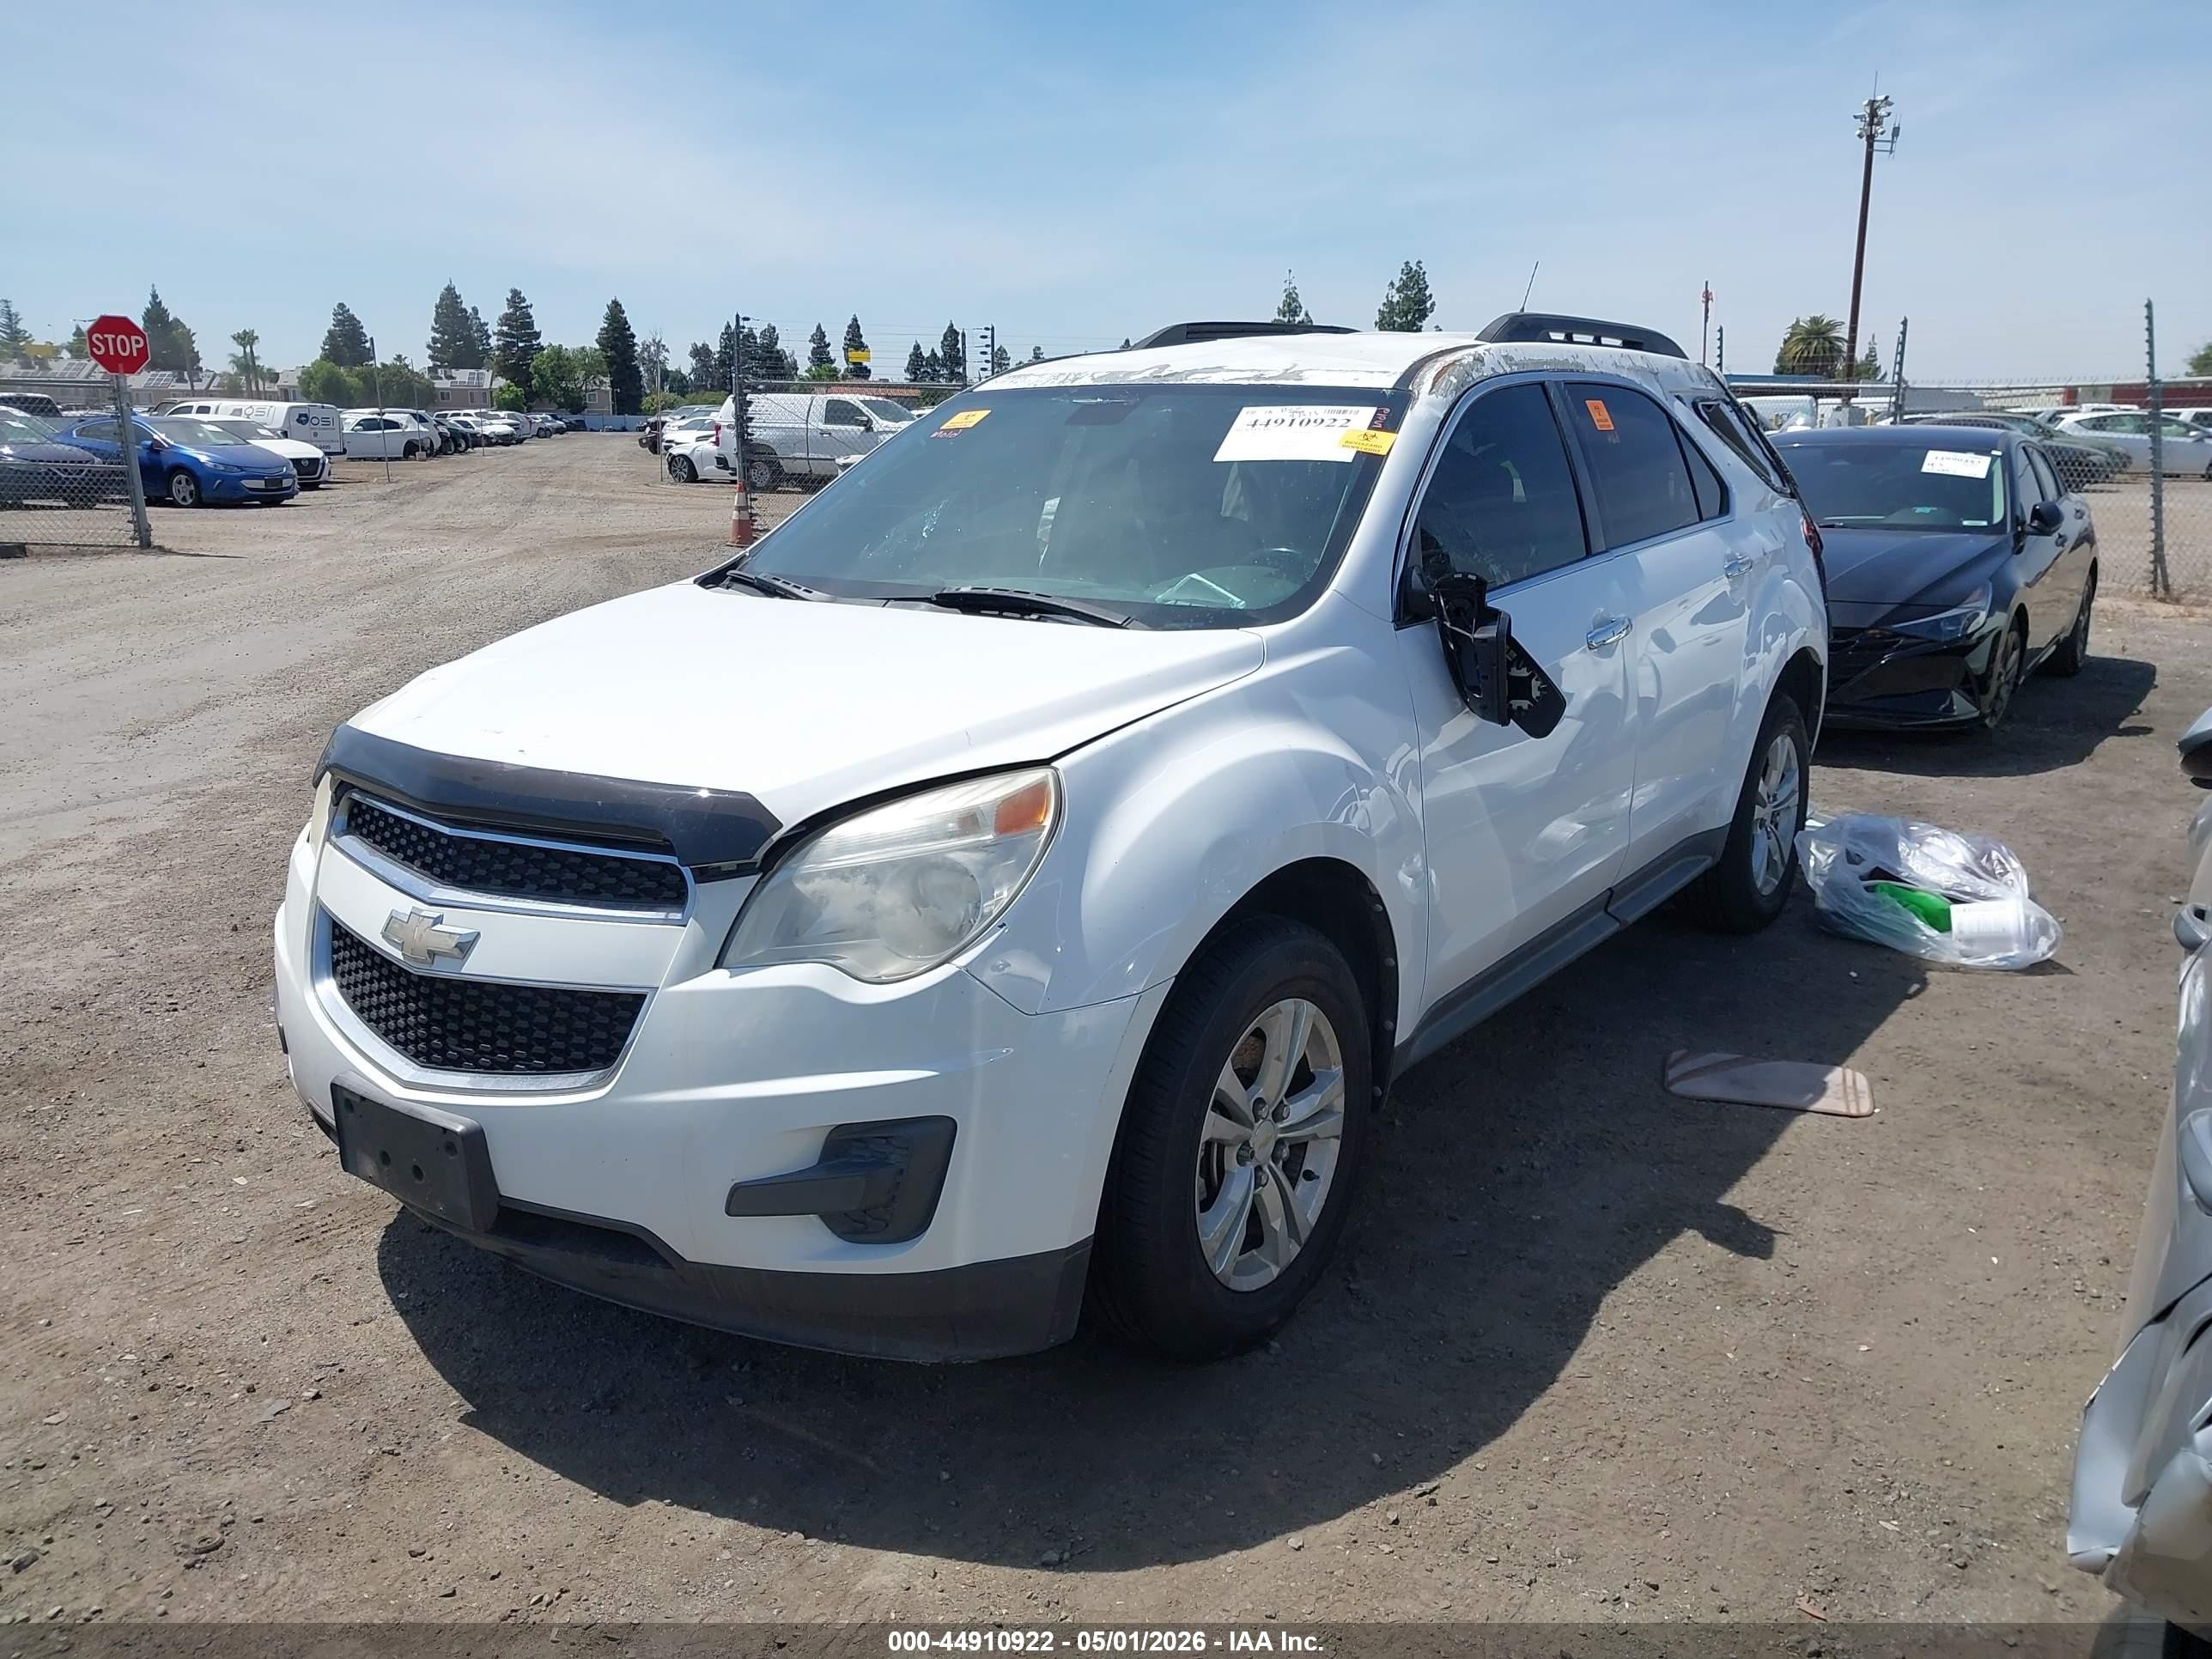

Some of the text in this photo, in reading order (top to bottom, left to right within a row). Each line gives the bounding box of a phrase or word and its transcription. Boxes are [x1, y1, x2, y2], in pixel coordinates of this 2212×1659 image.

[91, 332, 144, 357] STOP
[310, 416, 335, 427] OSI
[1246, 417, 1352, 428] 44910922
